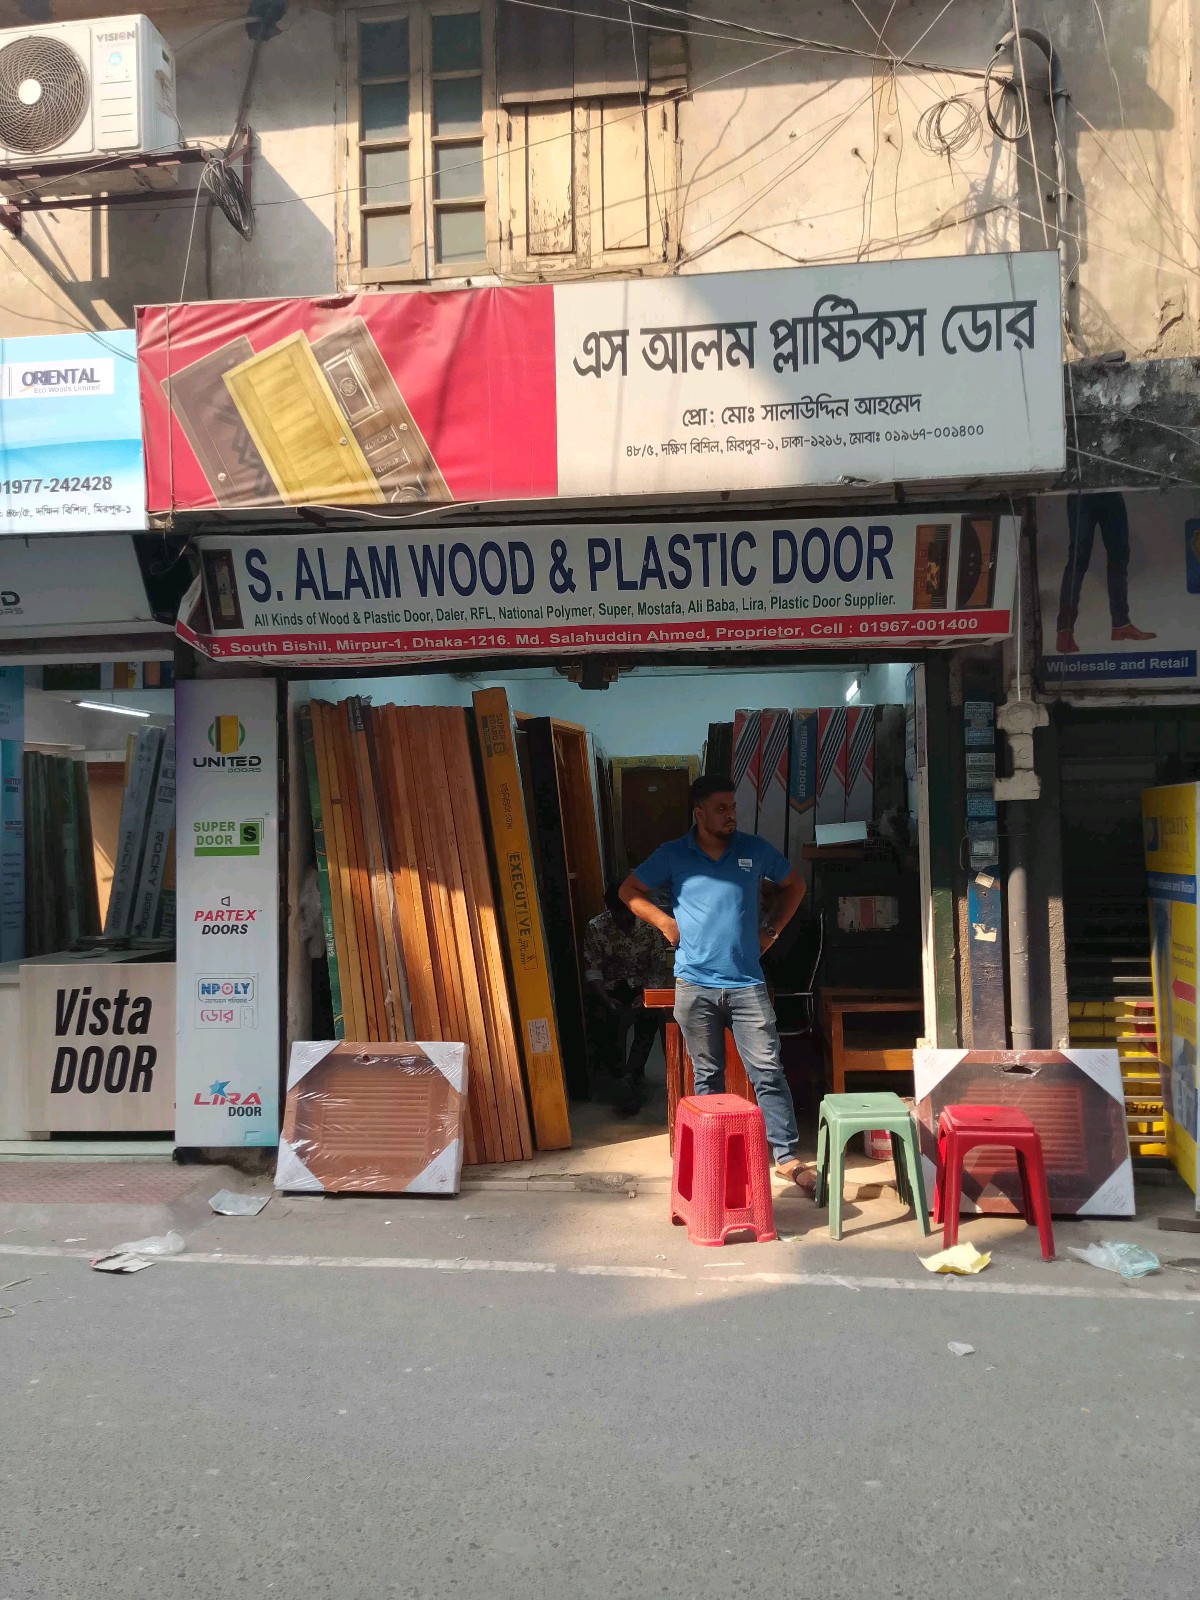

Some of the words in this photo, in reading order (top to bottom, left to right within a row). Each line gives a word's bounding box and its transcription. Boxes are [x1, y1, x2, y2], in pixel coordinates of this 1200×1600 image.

[96, 30, 135, 42] VISION
[572, 329, 630, 379] এস
[639, 320, 757, 374] আলম
[942, 300, 1037, 355] ডোর
[21, 367, 101, 387] ORIENTAL
[33, 385, 47, 394] Eco
[48, 384, 72, 394] Woods
[73, 383, 101, 393] Limited
[761, 393, 849, 422] সালাউদ্দিন
[854, 394, 922, 416] আহমেদ
[661, 439, 687, 456] দক্ষিণ
[885, 425, 984, 442] ০১৯৬৭-০০১৪০০
[0, 476, 112, 495] 1977-242428
[245, 548, 284, 603] S.
[295, 545, 402, 600] ALAM
[408, 541, 535, 597] WOOD
[549, 538, 577, 594] &
[587, 530, 757, 591] PLASTIC
[772, 525, 894, 584] DOOR
[254, 613, 269, 627] All
[271, 612, 304, 627] Kinds
[306, 611, 317, 625] of
[318, 611, 350, 625] Wood
[353, 611, 361, 624] &
[364, 609, 402, 624] Plastic
[404, 609, 434, 624] Door,
[436, 607, 468, 622] Daler,
[471, 606, 496, 621] RFL,
[498, 605, 544, 620] National
[547, 604, 596, 620] Polymer,
[598, 603, 634, 618] Super,
[637, 601, 685, 616] Mostafa,
[688, 599, 703, 613] Ali
[706, 598, 739, 613] Baba,
[742, 597, 767, 612] Lira,
[770, 595, 809, 610] Plastic
[813, 594, 841, 609] Door
[844, 592, 896, 609] Supplier.
[230, 641, 282, 653] South
[284, 640, 332, 653] Bishil,
[336, 638, 408, 651] Mirpur-1,
[412, 633, 511, 649] Dhaka-1216.
[516, 634, 544, 645] Md.
[550, 631, 642, 645] Salahuddin
[646, 628, 711, 641] Ahmed,
[716, 625, 805, 641] Proprietor,
[810, 623, 843, 635] Cell
[859, 618, 978, 634] 01967-001400
[1046, 659, 1117, 672] Wholesale
[1120, 658, 1146, 670] and
[1150, 656, 1189, 669] Retail
[496, 713, 506, 740] SUPER
[798, 725, 808, 769] FRIENDLY
[192, 755, 262, 769] UNITED
[798, 770, 807, 798] DOOR
[193, 821, 236, 833] SUPER
[196, 835, 233, 846] DOOR
[149, 831, 162, 887] ROCKY
[509, 853, 530, 937] EXECUTIVE
[194, 909, 257, 922] PARTEX
[201, 923, 249, 935] DOORS
[201, 982, 251, 996] NPOLY
[54, 986, 153, 1036] Vista
[200, 1009, 234, 1023] ডোর
[50, 1044, 157, 1094] DOOR
[193, 1092, 262, 1106] LIRA
[228, 1107, 262, 1117] DOOR
